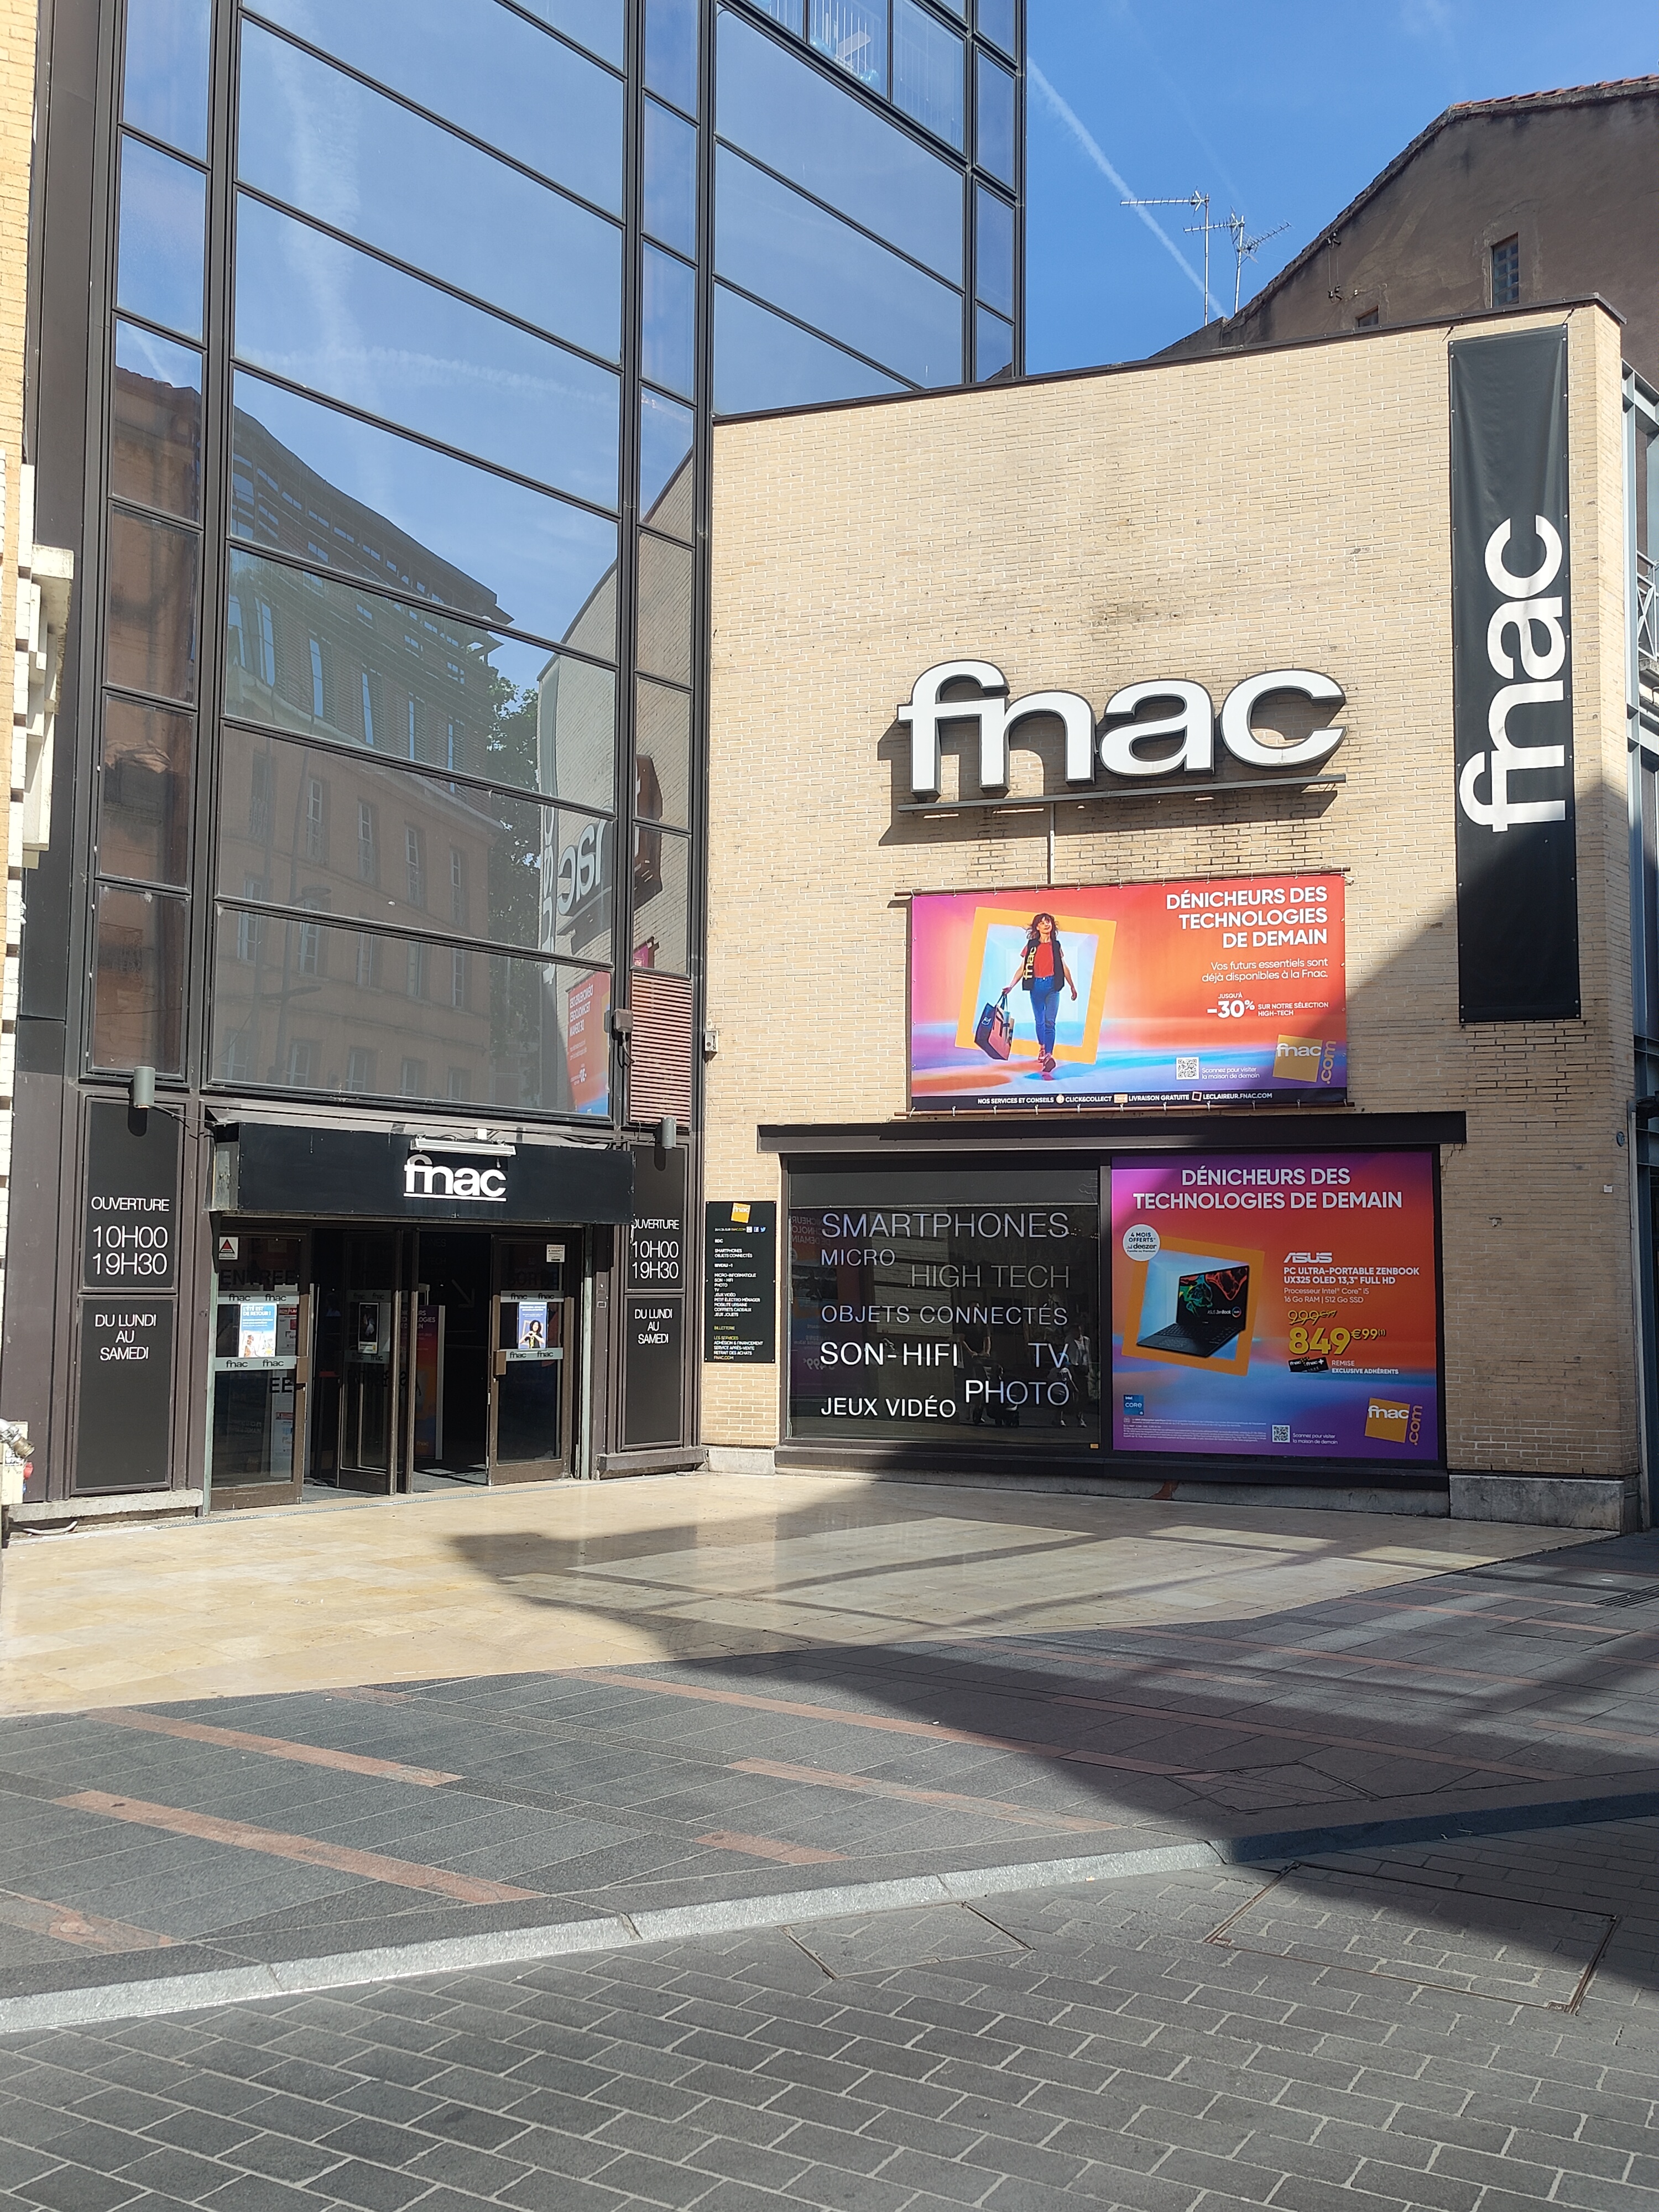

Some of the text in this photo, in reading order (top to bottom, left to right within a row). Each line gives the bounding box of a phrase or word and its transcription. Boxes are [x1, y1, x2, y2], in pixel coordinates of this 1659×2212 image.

[1459, 514, 1567, 833] fnac
[897, 660, 1345, 797] fnac
[1166, 886, 1327, 910] DÉNICHEURS DES
[1178, 907, 1327, 930] TECHNOLOGIES
[1223, 928, 1327, 948] DE DEMAIN
[1023, 946, 1037, 980] fnac
[1211, 958, 1328, 971] Vos futurs essentiels sont
[1202, 969, 1328, 984] déjà disponibles à la Fnac.
[1207, 999, 1255, 1018] -30%
[1276, 1043, 1322, 1057] fnac
[1321, 1041, 1337, 1084] .com
[404, 1154, 507, 1198] fnac
[1182, 1165, 1350, 1186] DÉNICHEURS DES
[91, 1197, 170, 1212] OUVERTURE
[1133, 1191, 1403, 1209] TECHNOLOGIES DE DEMAIN
[822, 1213, 1069, 1238] SMARTPHONES
[93, 1225, 168, 1249] 10H00
[632, 1240, 679, 1258] 10H00
[821, 1249, 895, 1266] MICRO
[1284, 1253, 1332, 1263] ASUS
[92, 1253, 167, 1275] 19H30
[632, 1261, 679, 1279] 19H30
[1376, 1267, 1420, 1275] ZENBOOK
[912, 1265, 1070, 1288] HIGH TECH
[1338, 1276, 1358, 1285] 13,3"
[95, 1314, 156, 1327] DU LUNDI
[635, 1308, 672, 1319] DU LUNDI
[822, 1303, 1068, 1325] OBJETS CONNECTÉS
[648, 1321, 659, 1331] AU
[116, 1330, 134, 1343] AU
[638, 1334, 668, 1344] SAMEDI
[100, 1347, 149, 1360] SAMEDI
[820, 1342, 958, 1366] SON-HIFI
[1028, 1343, 1068, 1368] TV
[966, 1380, 1070, 1405] PHOTO
[821, 1395, 956, 1418] JEUX VIDÉO
[1368, 1405, 1410, 1419] fnac
[1409, 1405, 1423, 1446] .com
